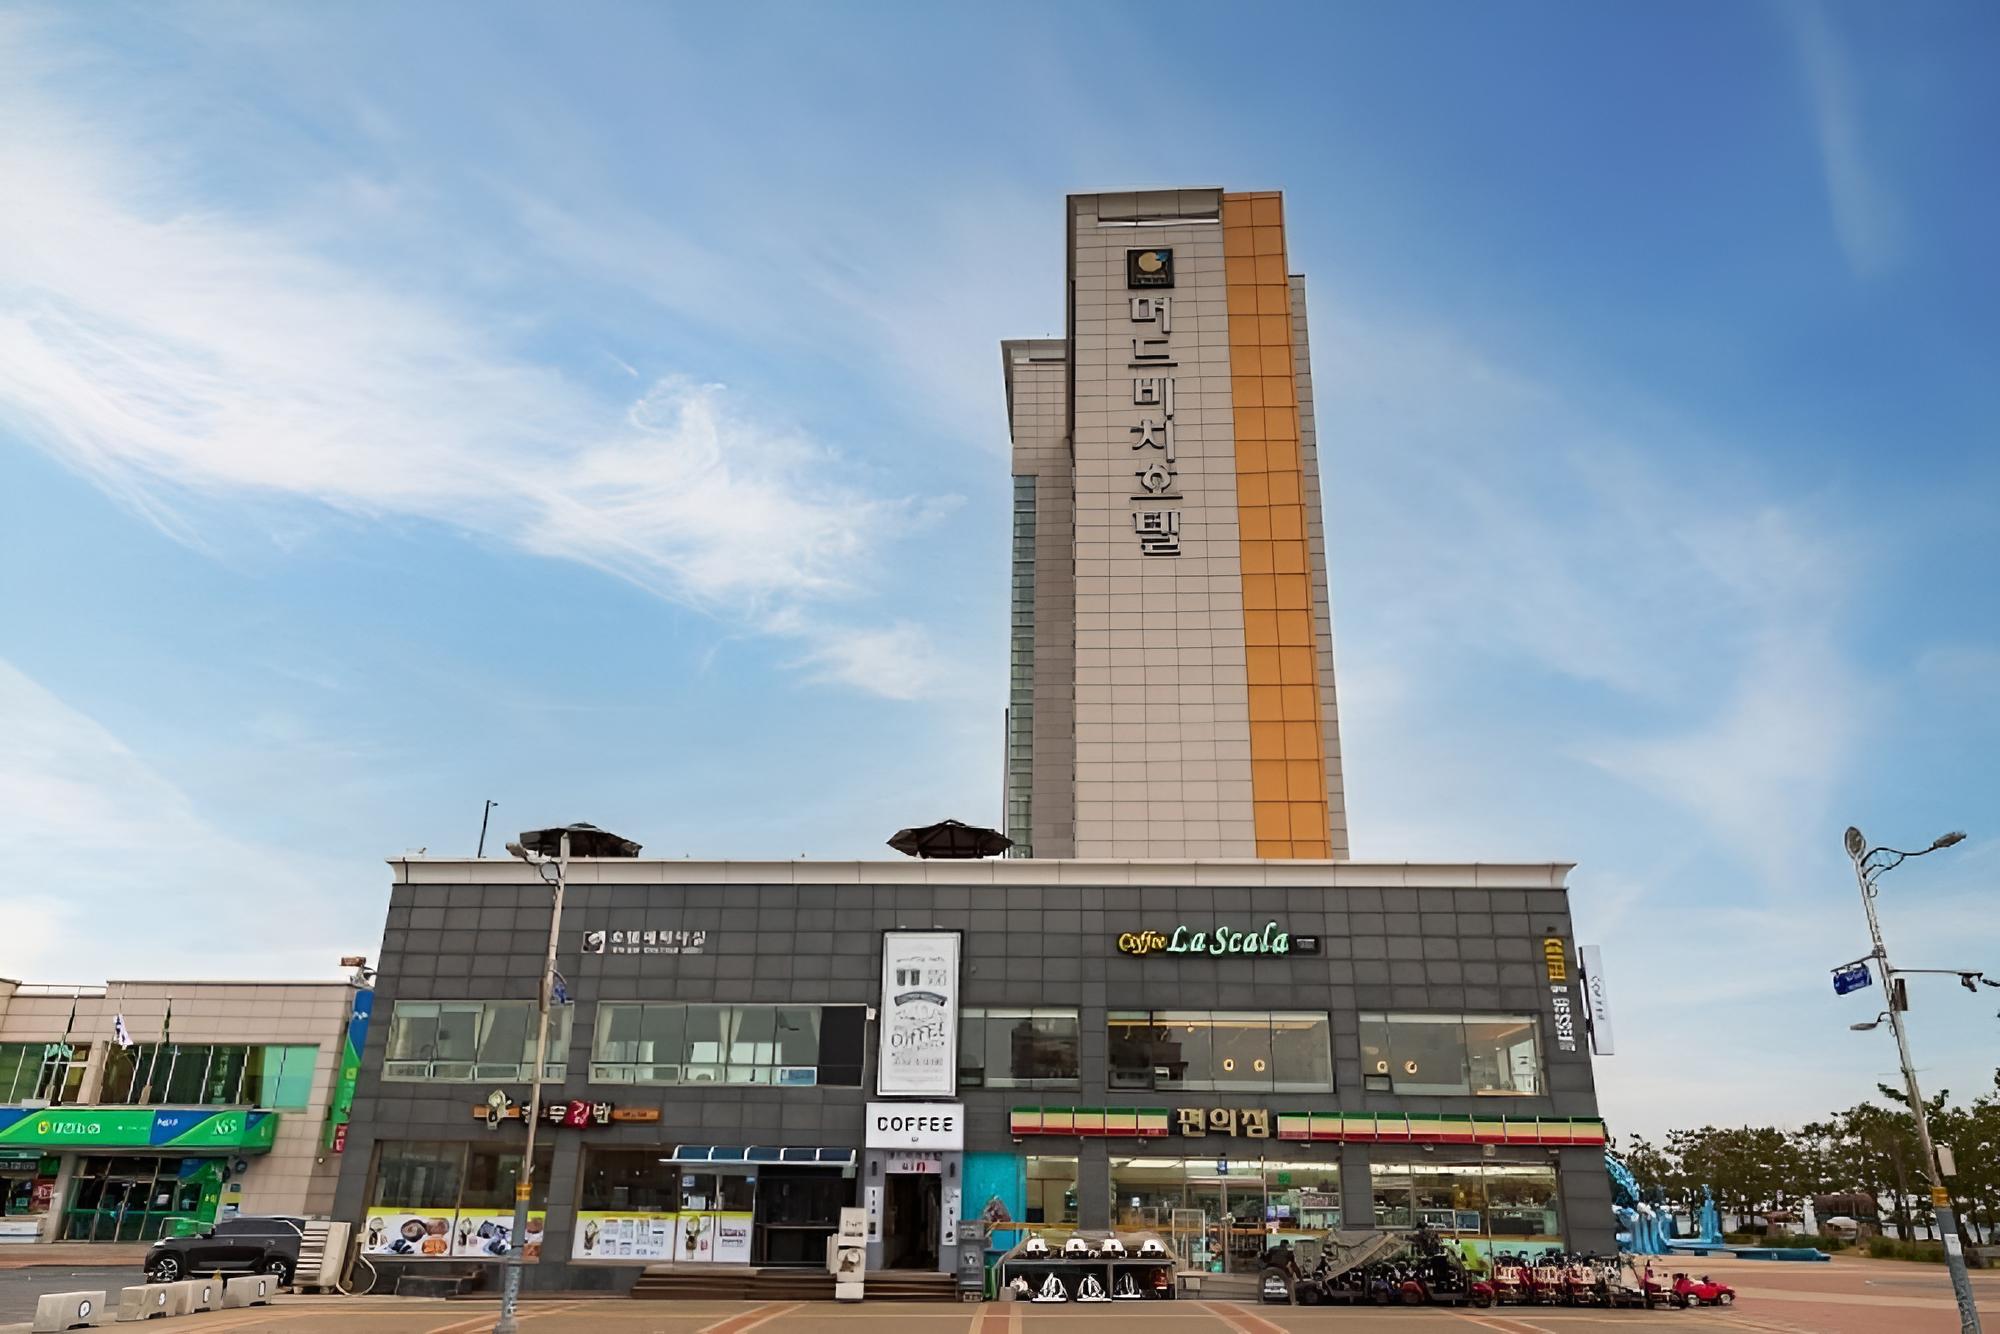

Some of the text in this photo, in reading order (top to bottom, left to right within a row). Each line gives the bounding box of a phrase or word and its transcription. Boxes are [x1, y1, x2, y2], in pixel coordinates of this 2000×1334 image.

[1128, 296, 1183, 556] 머드비치호텔
[1166, 925, 1206, 953] La
[1209, 921, 1290, 955] Scala
[877, 1116, 953, 1132] COFFEE
[1176, 1107, 1270, 1138] 편의점
